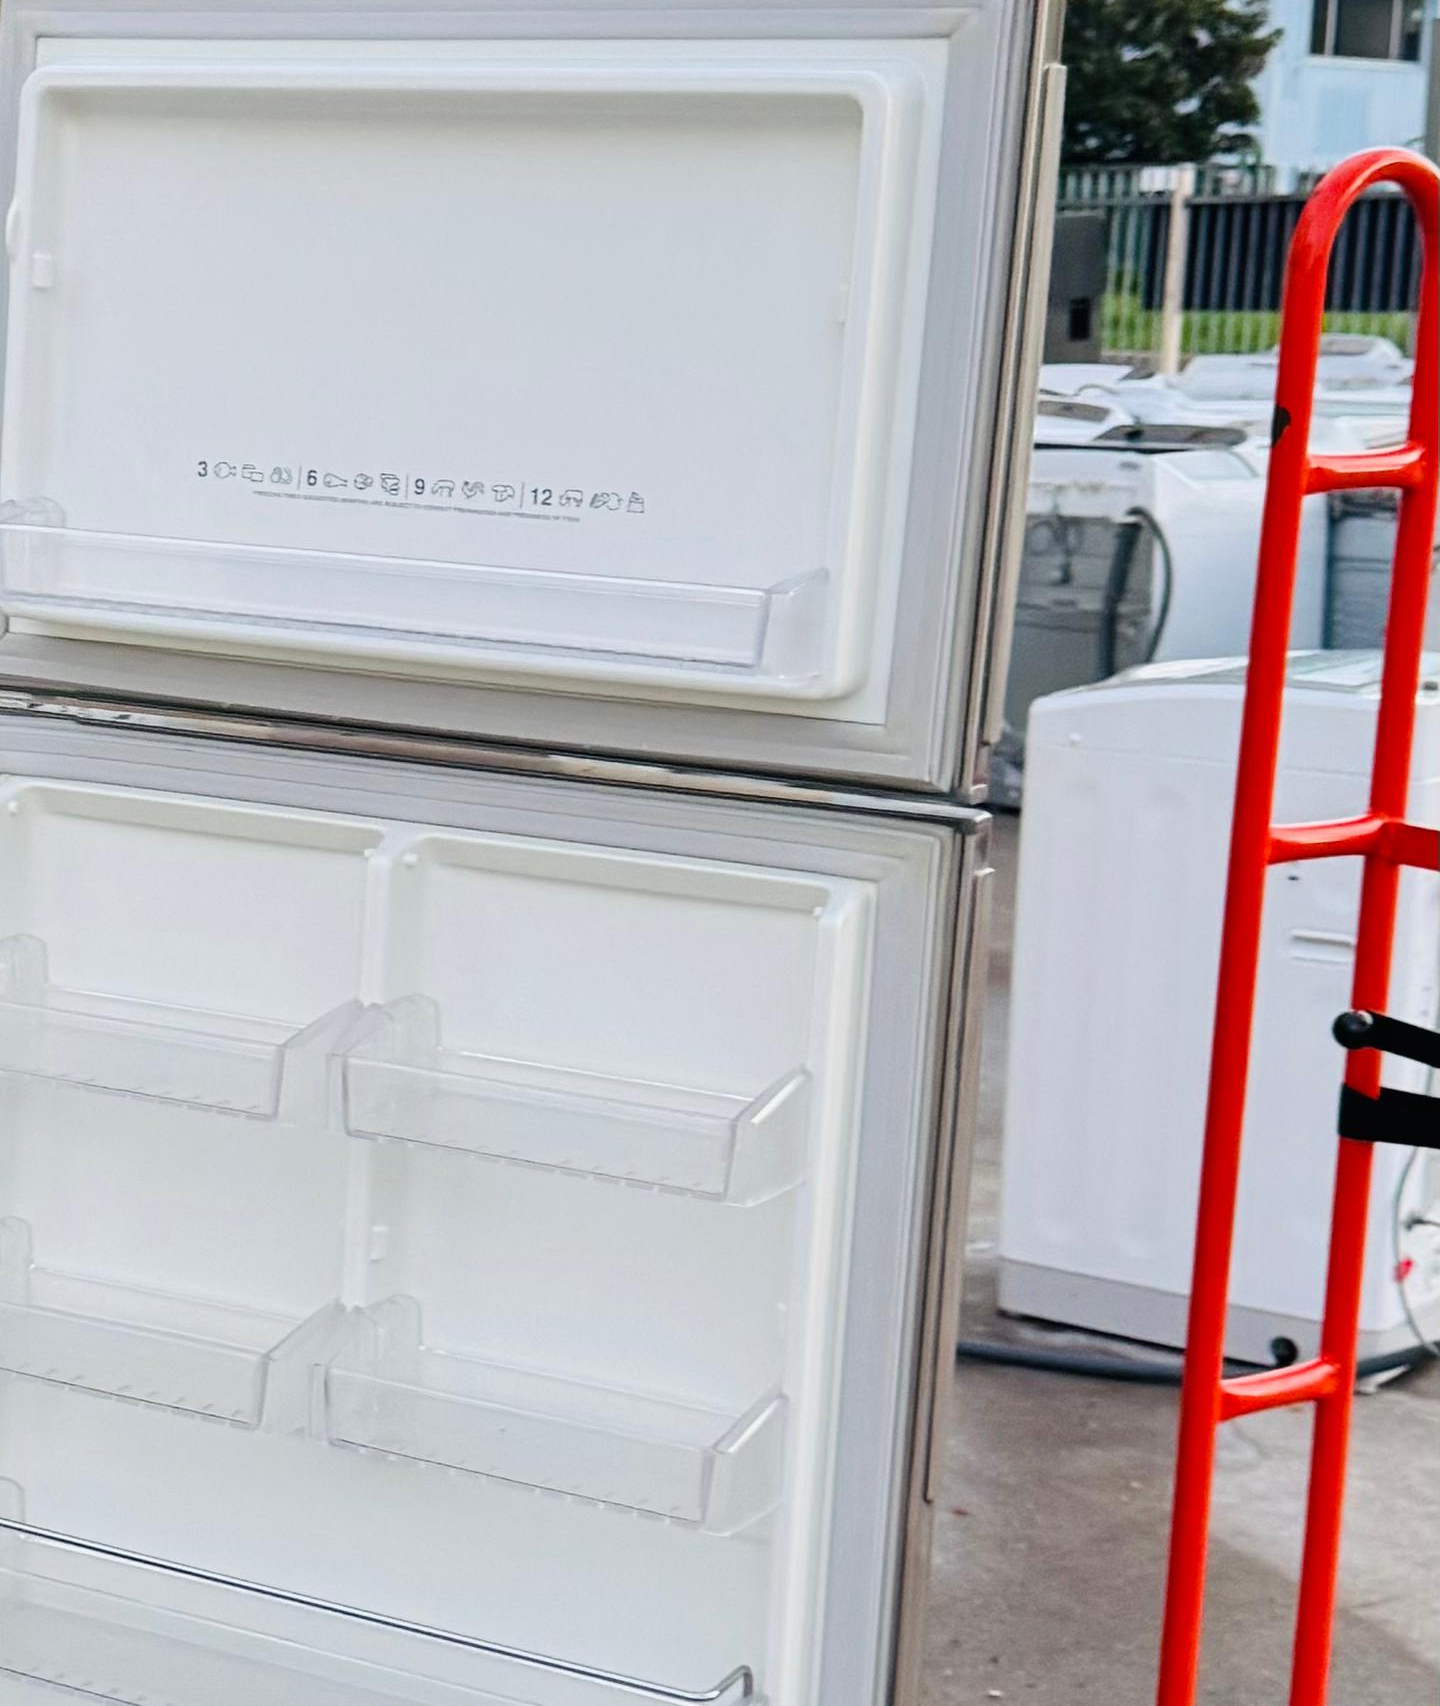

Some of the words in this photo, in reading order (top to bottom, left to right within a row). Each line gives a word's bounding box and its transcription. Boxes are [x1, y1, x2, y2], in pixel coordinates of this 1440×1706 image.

[197, 460, 208, 477] 3
[306, 469, 318, 486] 6
[414, 478, 425, 495] 9
[531, 488, 553, 506] 12
